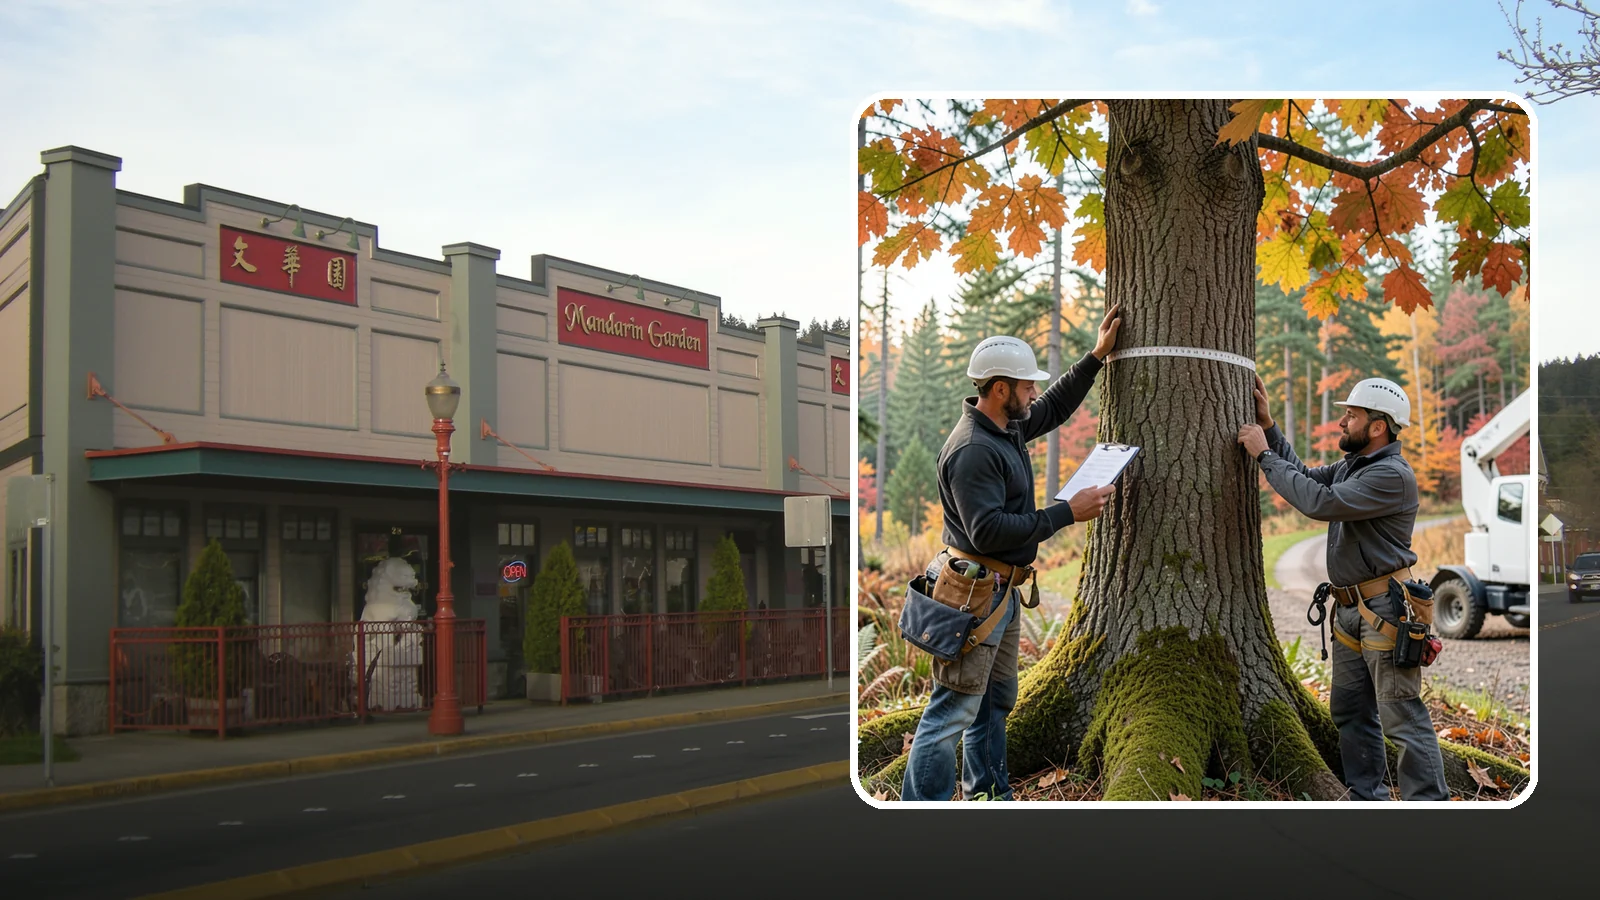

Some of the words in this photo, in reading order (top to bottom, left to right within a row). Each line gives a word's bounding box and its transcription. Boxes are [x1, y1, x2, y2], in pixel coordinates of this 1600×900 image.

[231, 236, 346, 291] 文華園
[564, 302, 644, 341] Mandarin
[648, 320, 701, 352] Garden
[503, 565, 527, 578] OPEN
